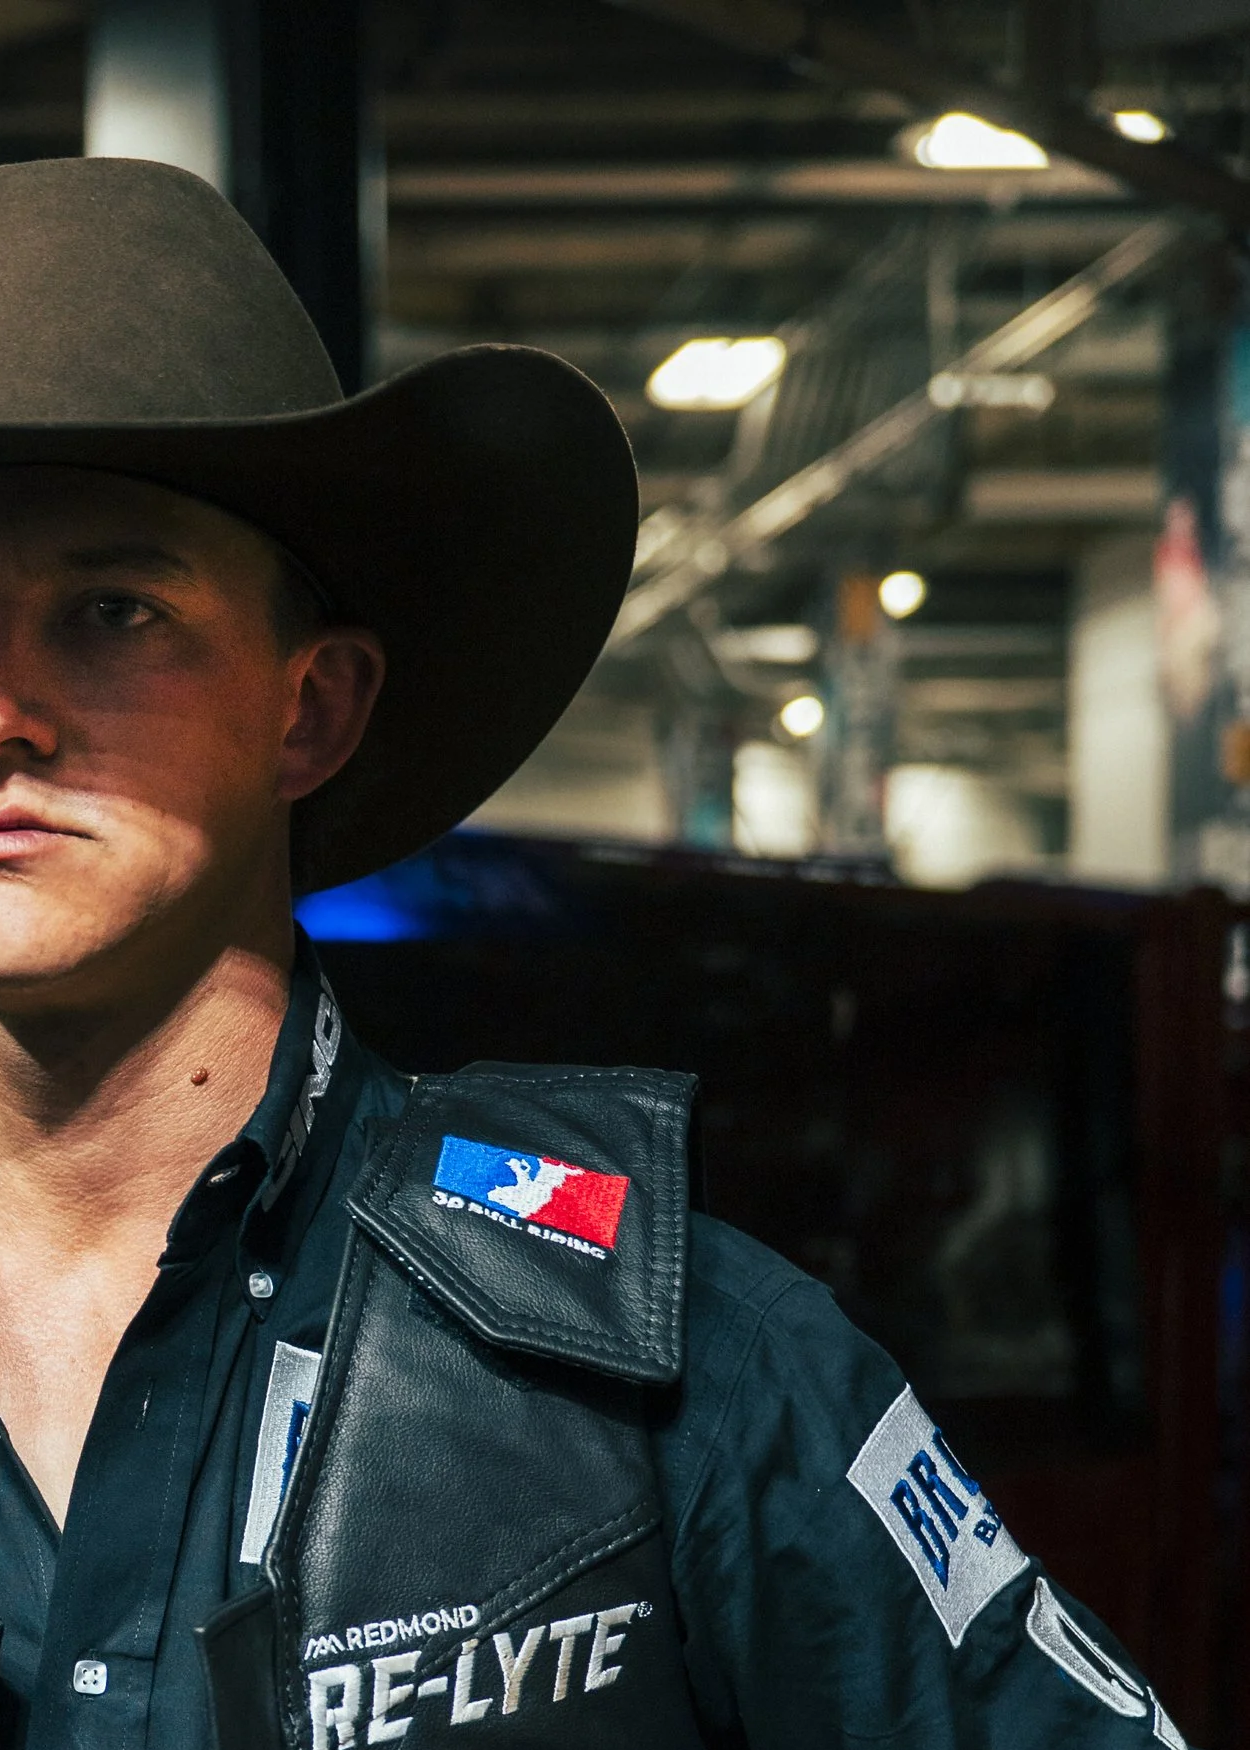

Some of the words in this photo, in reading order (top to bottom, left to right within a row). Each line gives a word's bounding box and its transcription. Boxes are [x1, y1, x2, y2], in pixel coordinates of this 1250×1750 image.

[468, 1202, 523, 1231] BULL
[527, 1224, 607, 1261] RIDING
[347, 1604, 481, 1652] REDMOND
